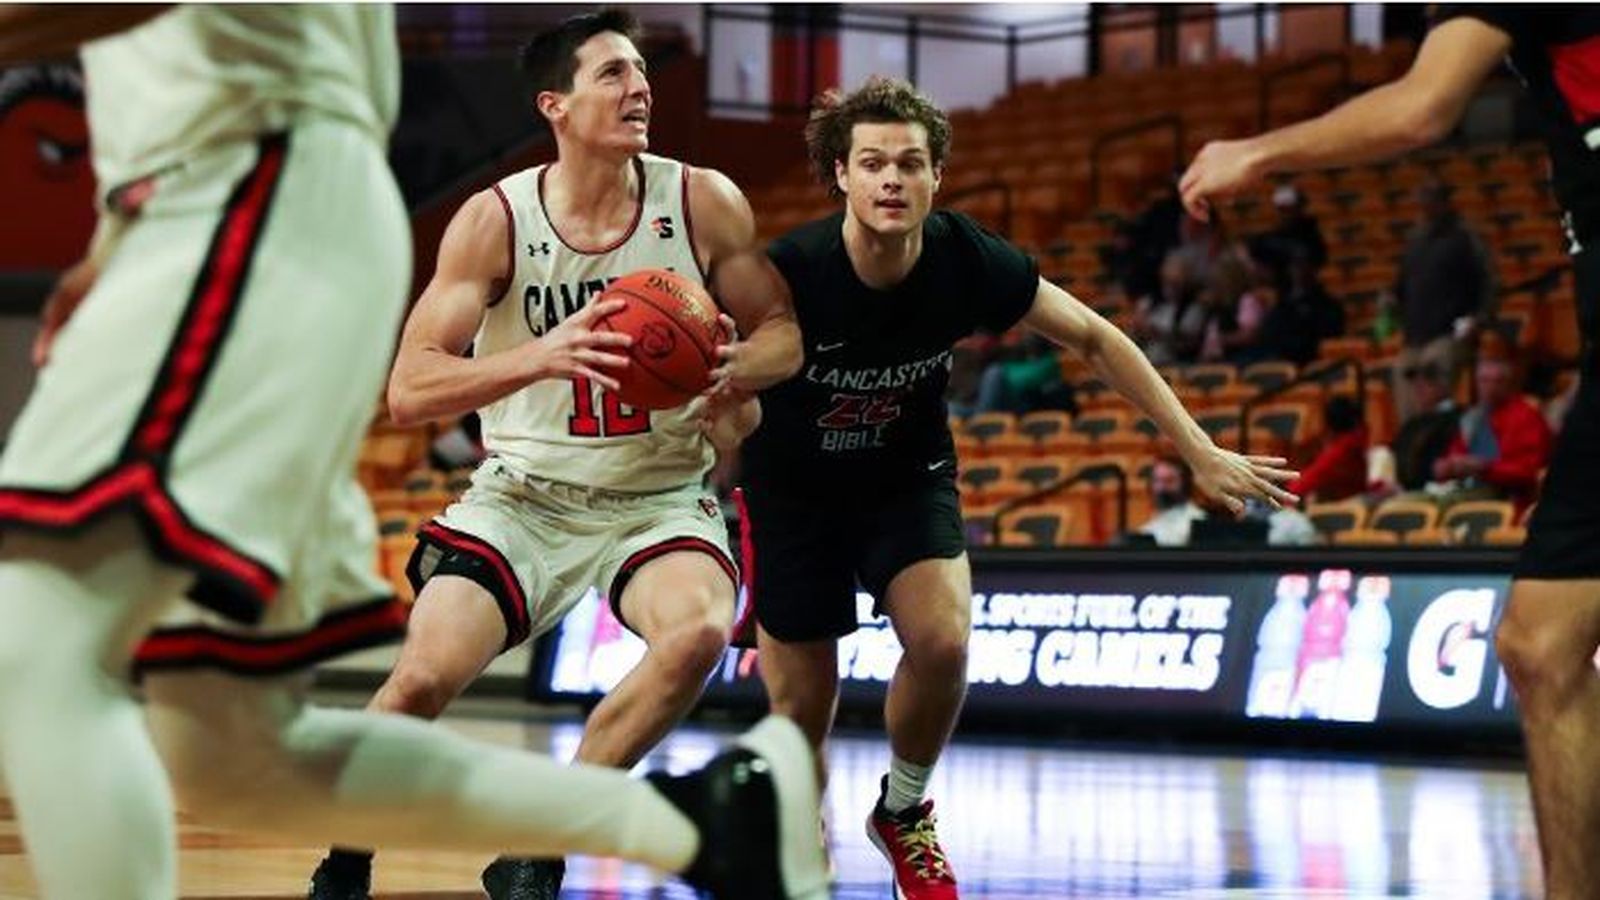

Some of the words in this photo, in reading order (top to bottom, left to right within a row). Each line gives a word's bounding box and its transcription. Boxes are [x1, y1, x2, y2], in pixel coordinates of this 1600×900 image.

[1138, 596, 1178, 629] OF
[1176, 597, 1231, 629] THE
[1036, 630, 1223, 691] CAMELS
